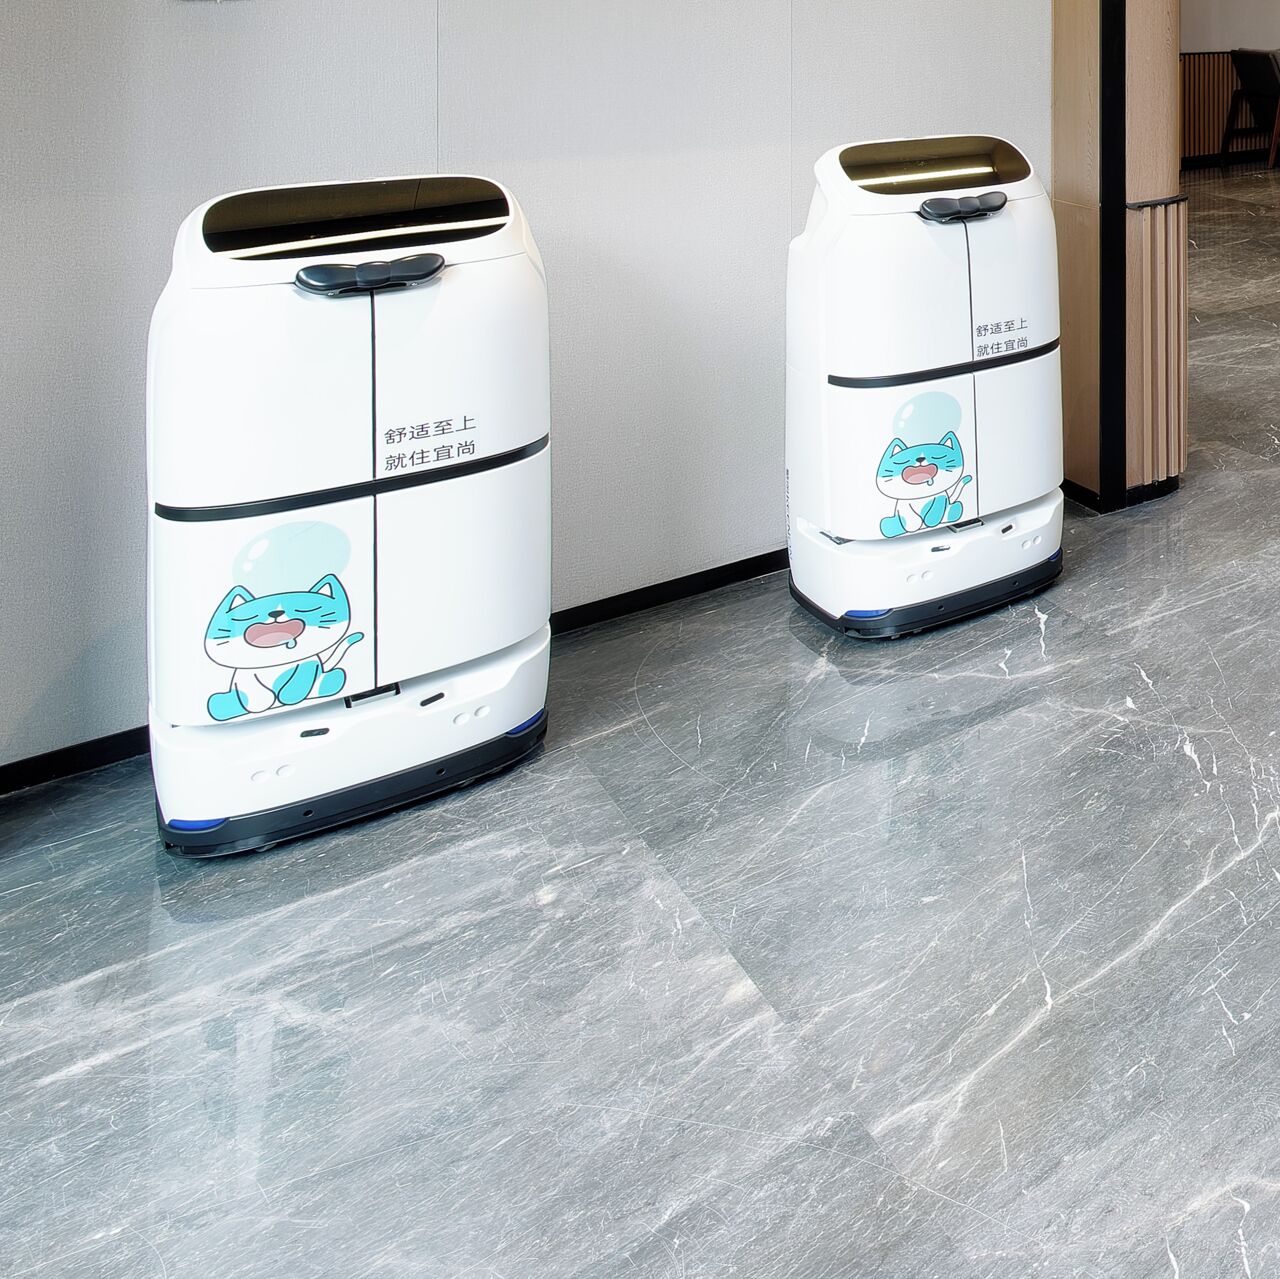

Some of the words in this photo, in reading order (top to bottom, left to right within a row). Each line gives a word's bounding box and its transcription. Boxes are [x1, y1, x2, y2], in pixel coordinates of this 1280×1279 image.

[975, 317, 1029, 338] 舒适至上
[976, 336, 1029, 358] 就住宜尚
[384, 415, 477, 445] 舒适至上
[384, 440, 476, 471] 就住宜尚
